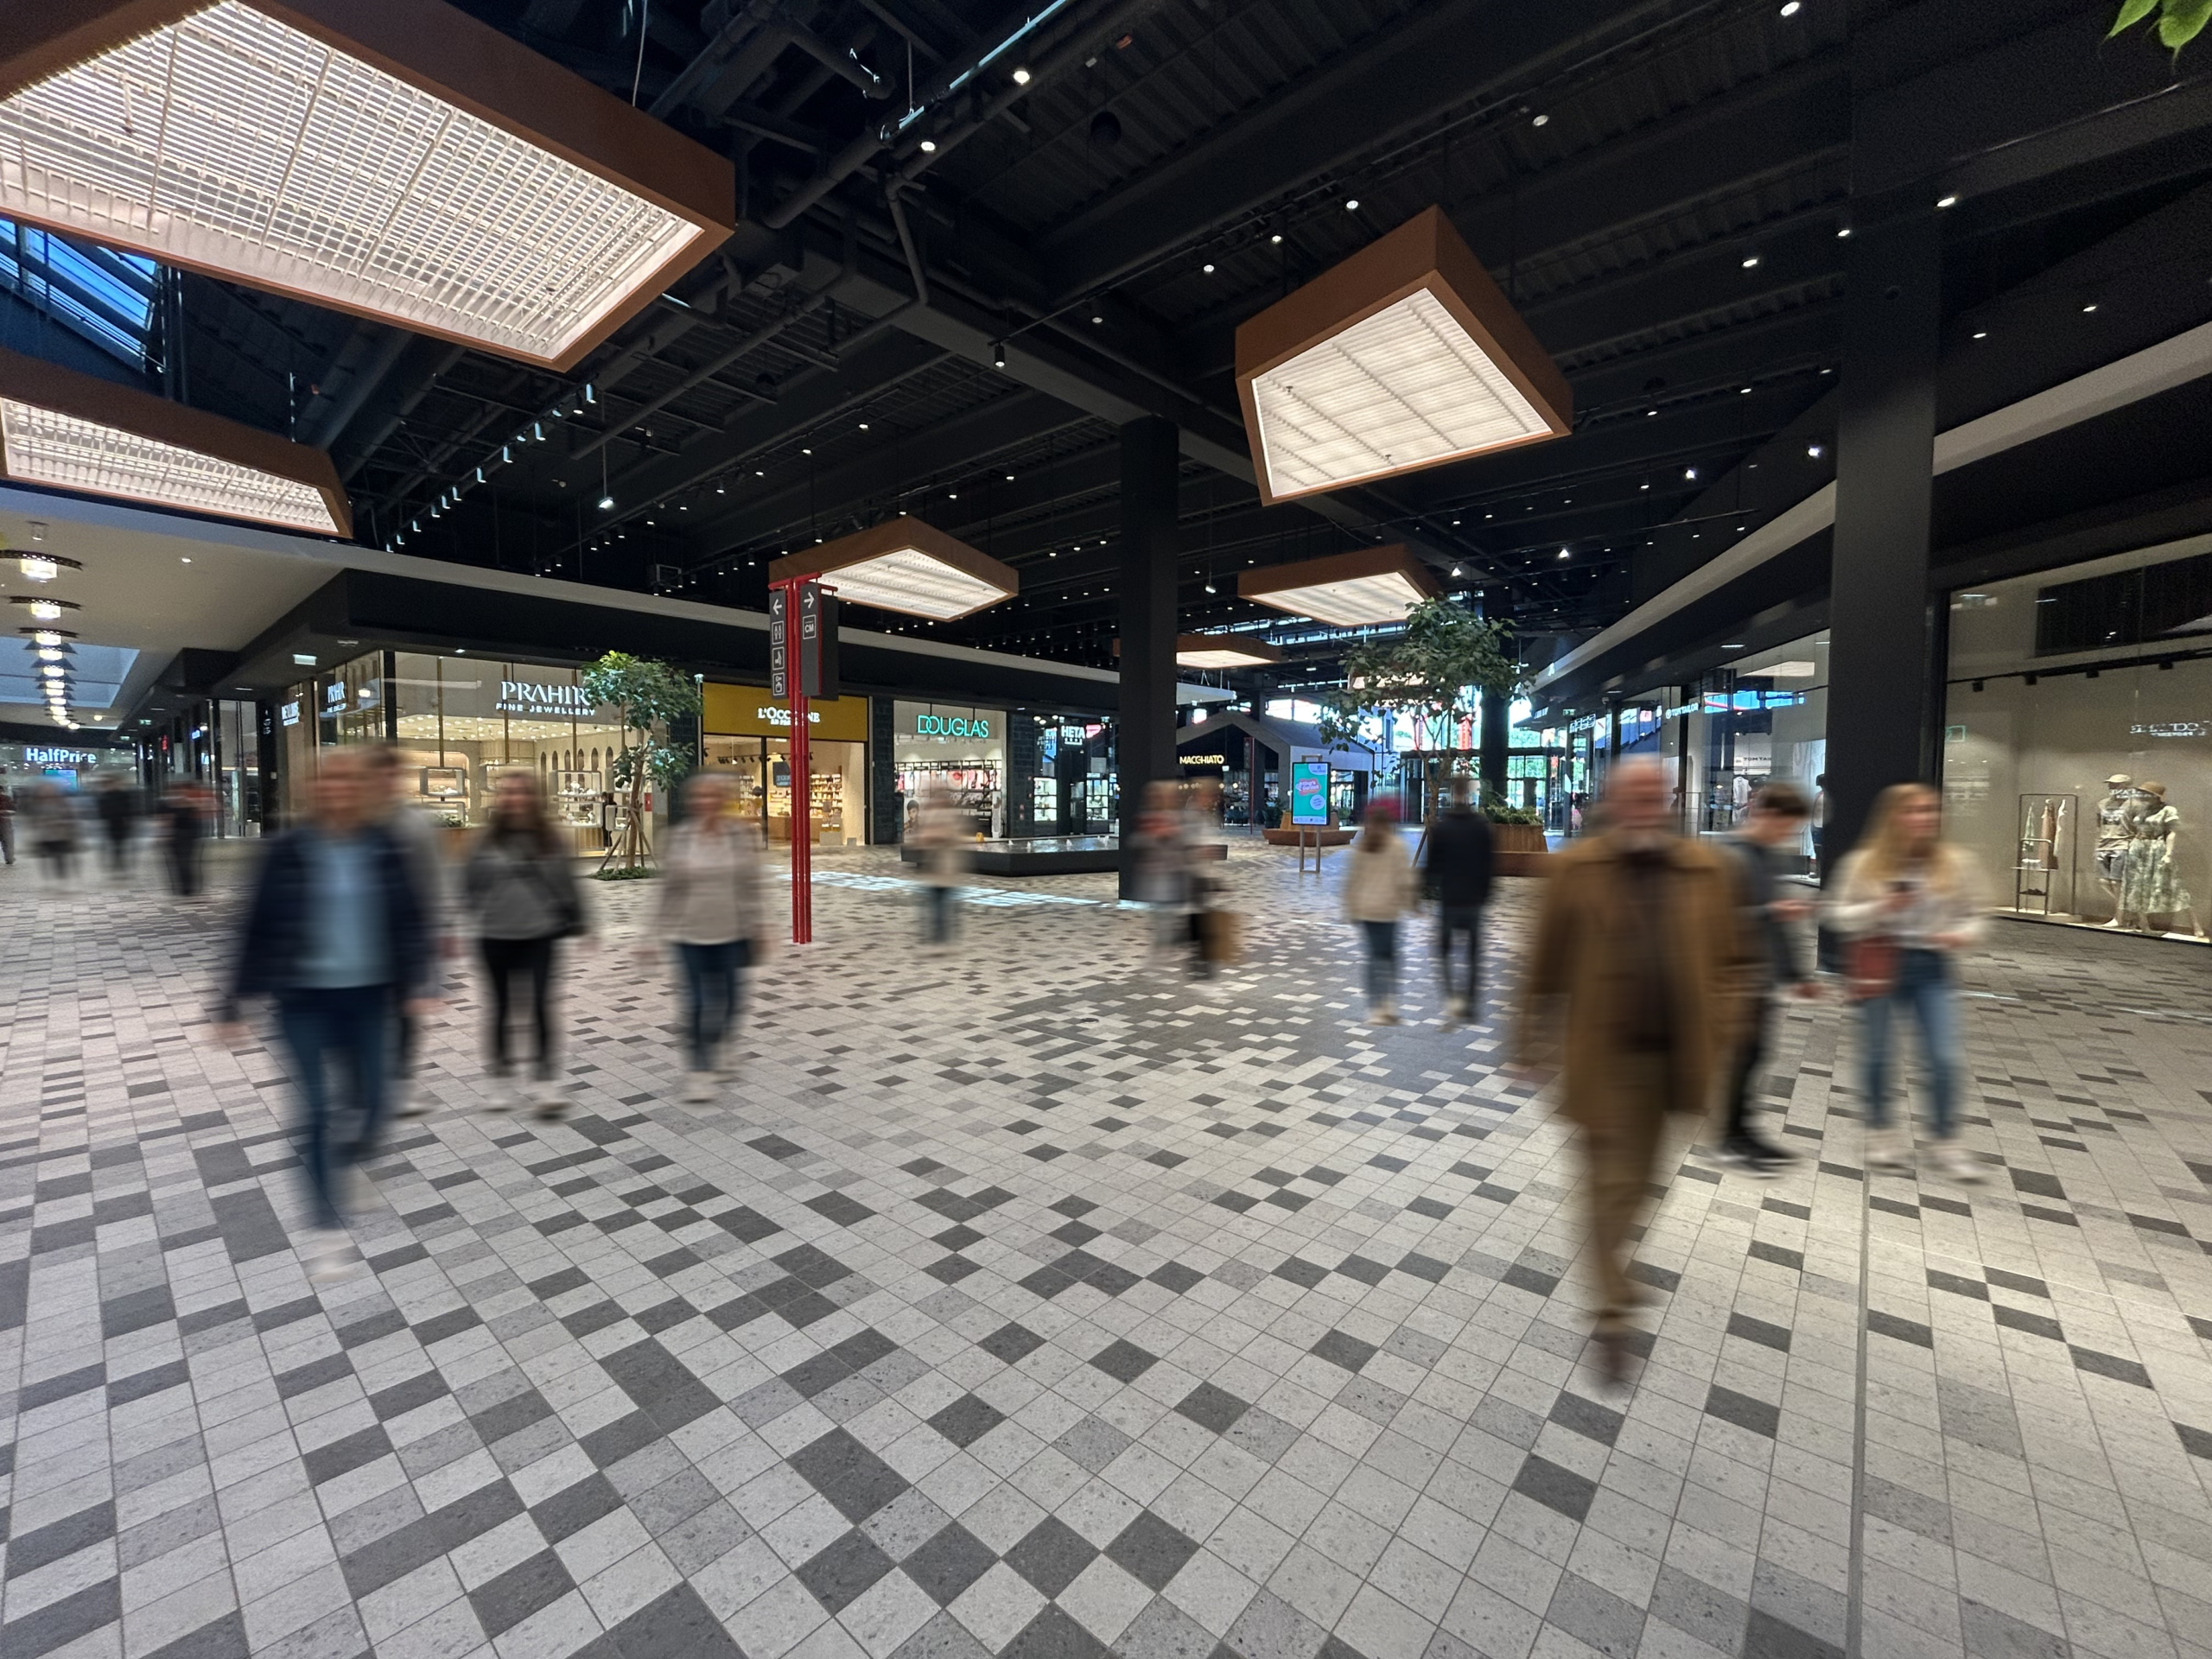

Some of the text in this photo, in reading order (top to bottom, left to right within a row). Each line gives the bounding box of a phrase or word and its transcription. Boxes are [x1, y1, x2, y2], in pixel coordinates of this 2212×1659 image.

[804, 624, 814, 633] CM
[501, 681, 591, 706] PRAHIR
[496, 702, 595, 716] FINE JEWELLERY
[918, 715, 989, 738] DOUGLAS
[1061, 725, 1085, 739] HETA
[1179, 754, 1224, 765] MACCHIATO
